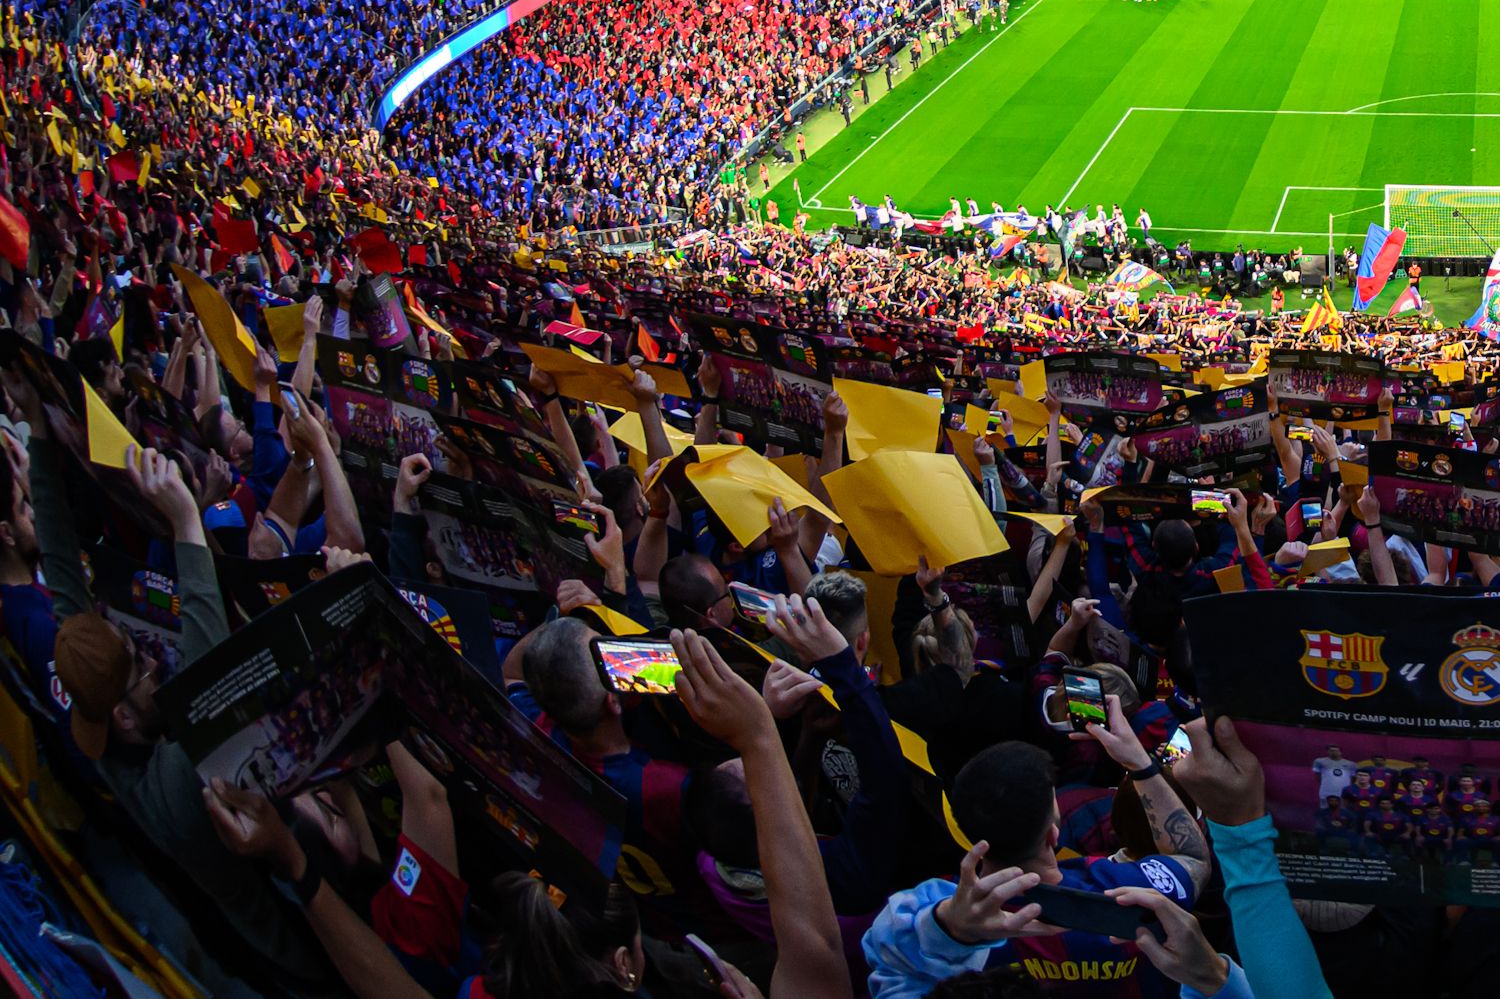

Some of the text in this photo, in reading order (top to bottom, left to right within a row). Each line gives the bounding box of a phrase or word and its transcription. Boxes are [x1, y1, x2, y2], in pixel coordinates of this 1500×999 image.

[1303, 708, 1350, 721] SPOTIFY
[1352, 712, 1388, 724] CAMP
[1389, 716, 1415, 726] NOU
[1424, 717, 1437, 727] 10
[1439, 718, 1471, 728] MAIG
